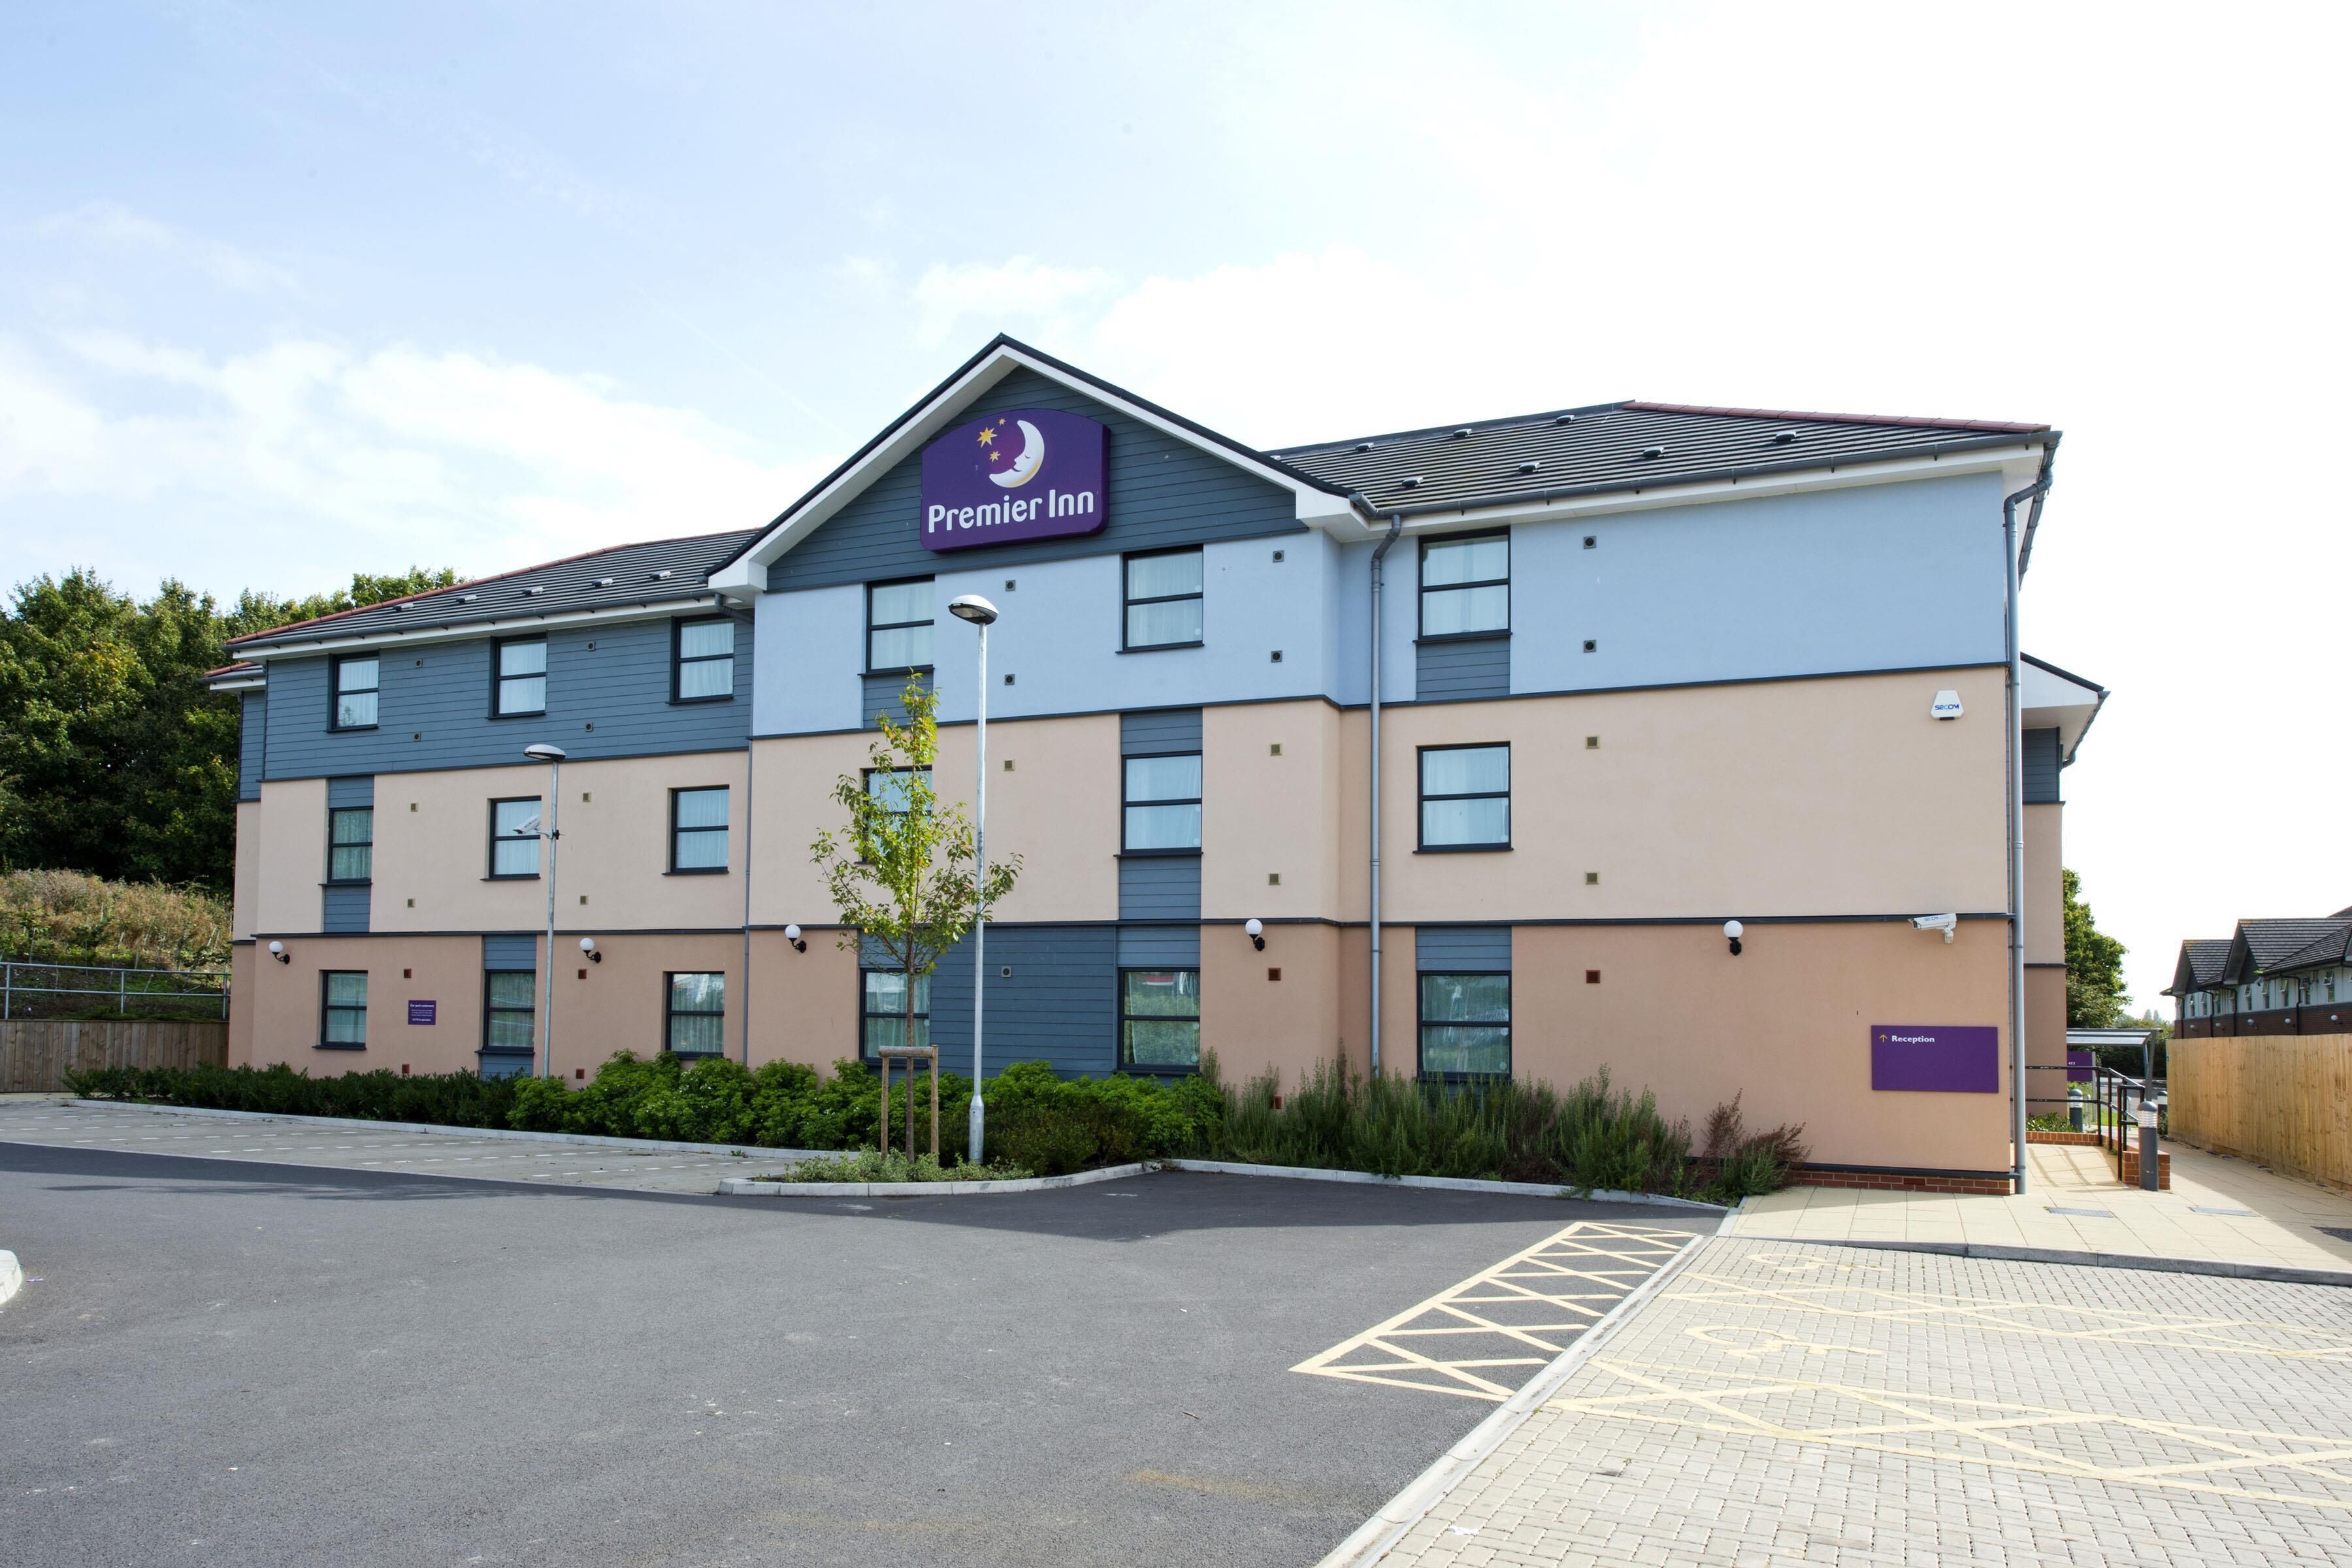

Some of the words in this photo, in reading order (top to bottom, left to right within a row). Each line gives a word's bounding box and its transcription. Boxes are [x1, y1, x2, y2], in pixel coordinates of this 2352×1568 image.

[928, 495, 1043, 533] Premier
[1049, 489, 1094, 518] Inn
[1891, 1035, 1935, 1044] Reception
